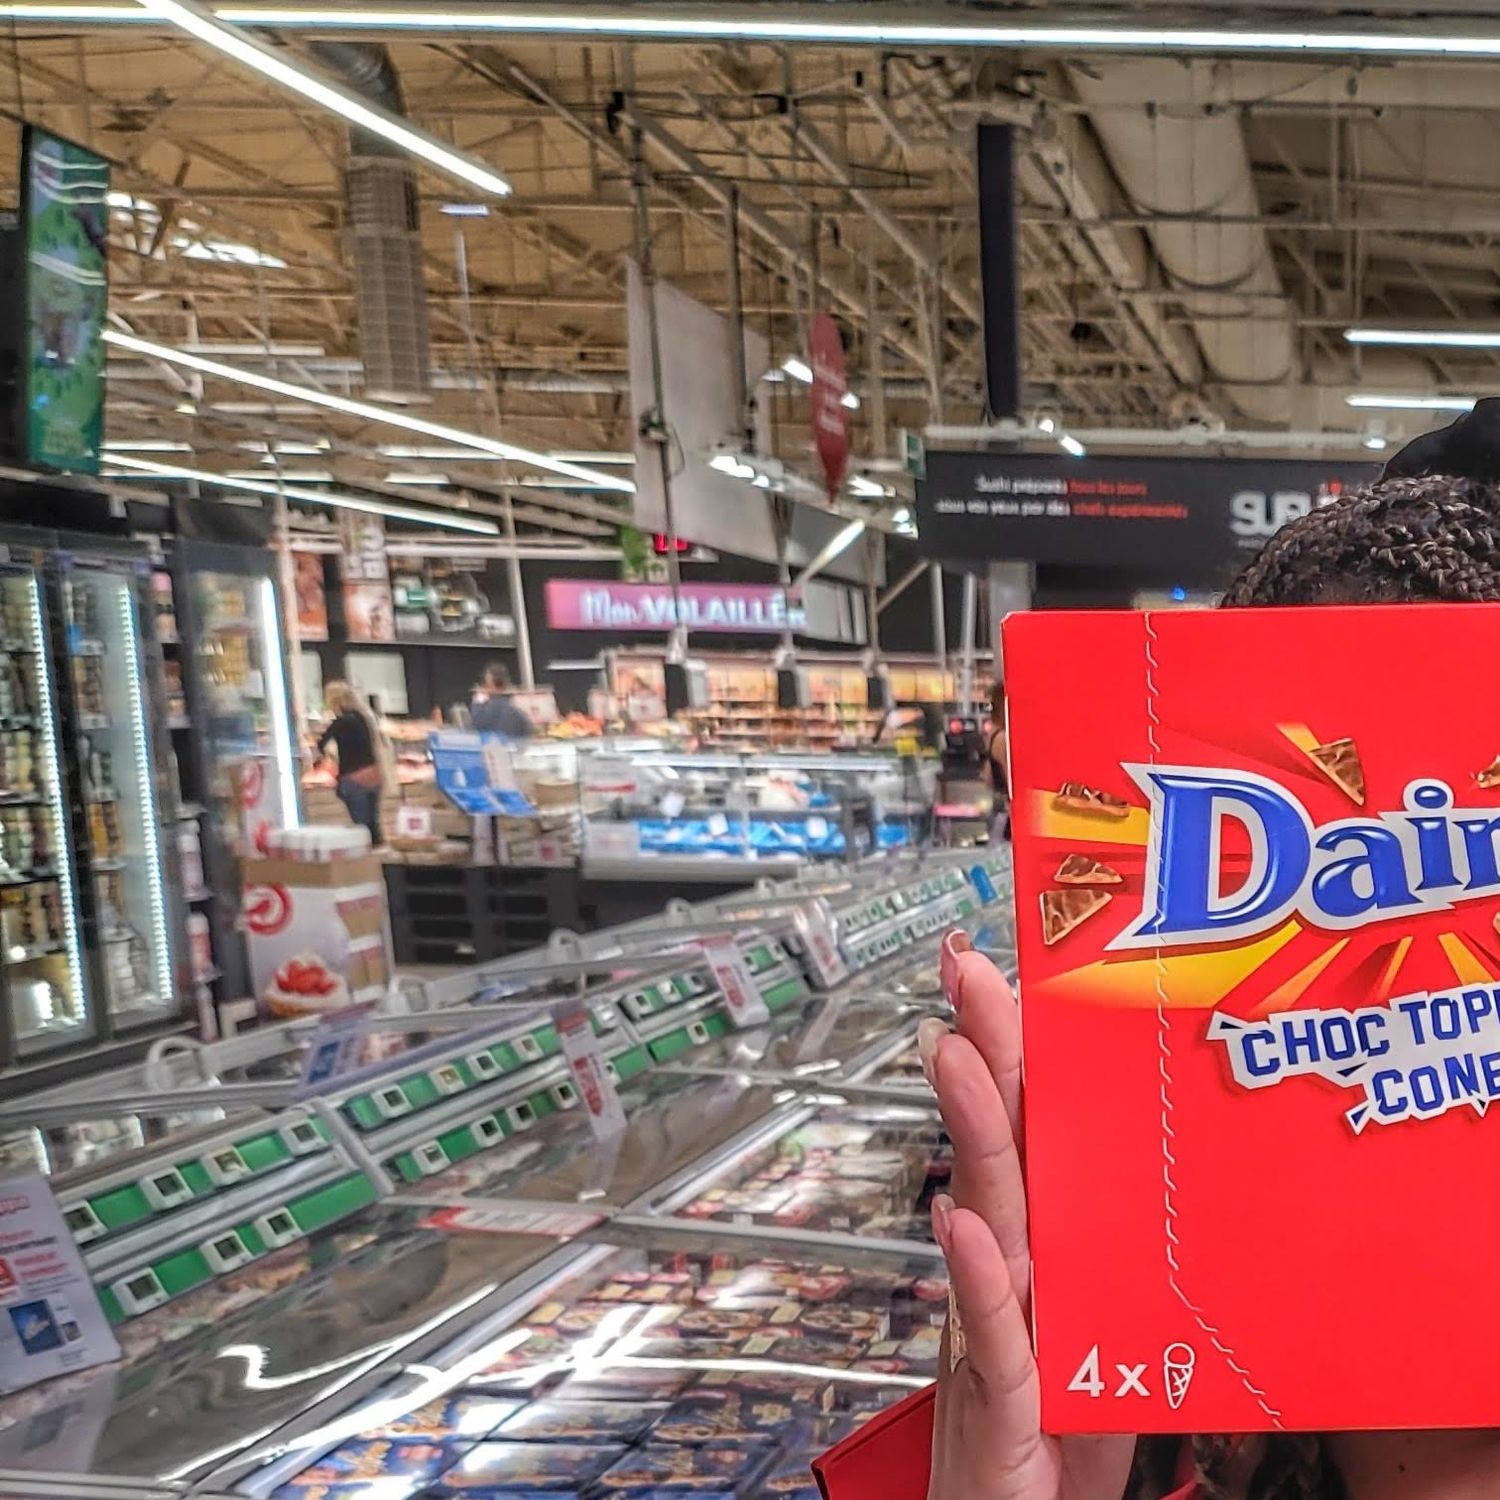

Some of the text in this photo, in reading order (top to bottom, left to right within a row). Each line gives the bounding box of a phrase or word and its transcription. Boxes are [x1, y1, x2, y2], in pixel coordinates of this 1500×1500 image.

[1243, 1010, 1390, 1079] CHOC
[1068, 1345, 1150, 1398] 4 x
